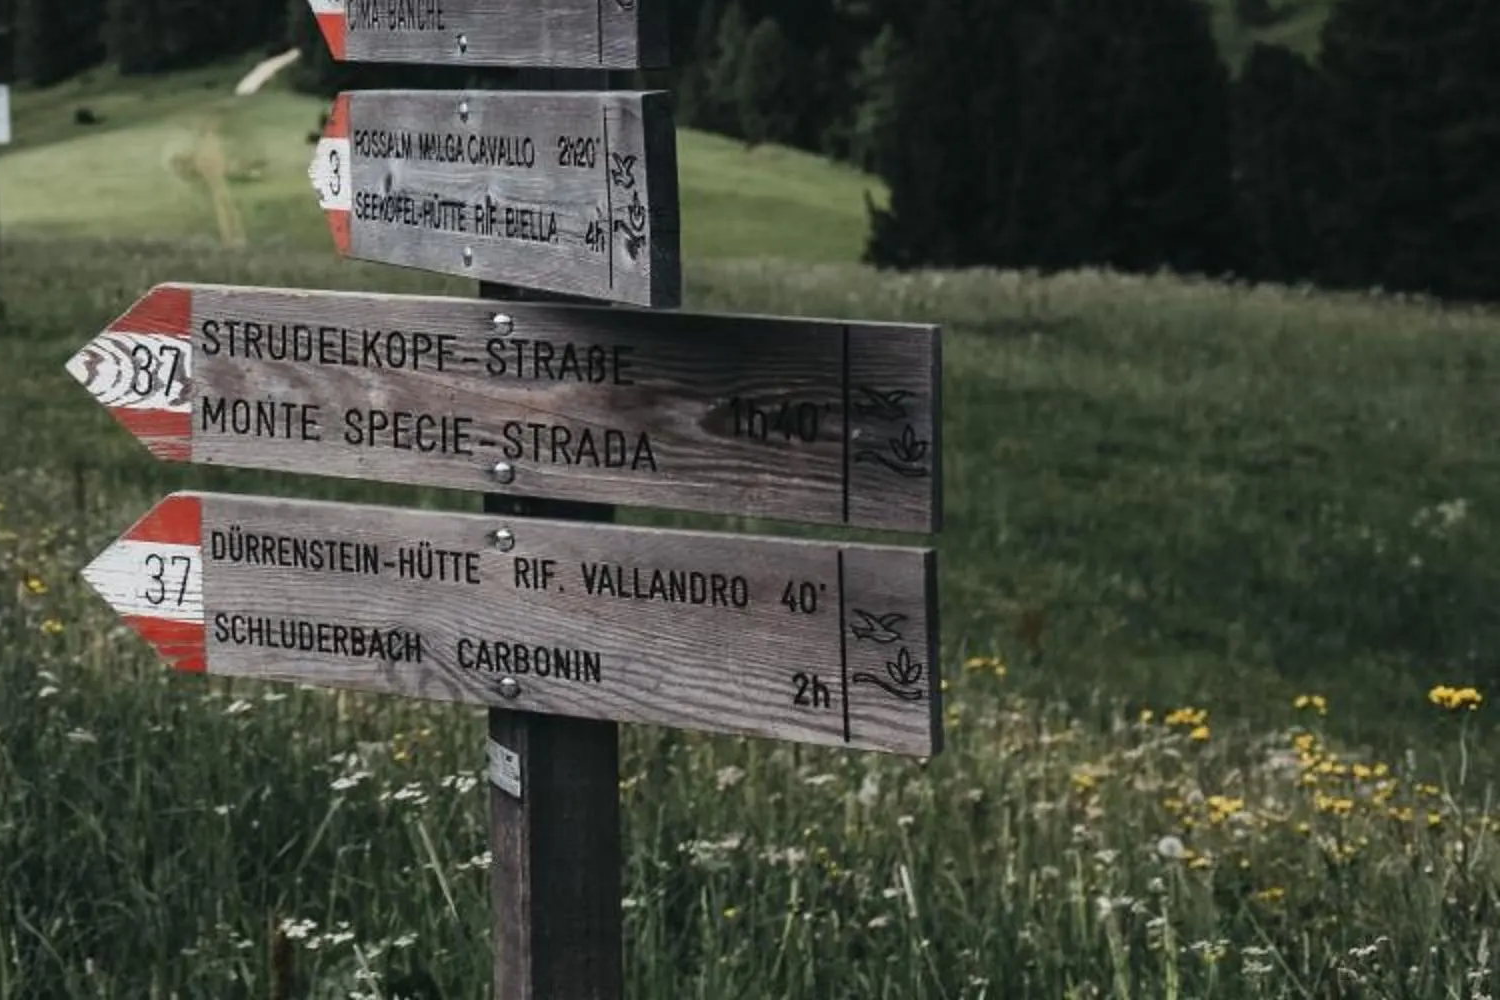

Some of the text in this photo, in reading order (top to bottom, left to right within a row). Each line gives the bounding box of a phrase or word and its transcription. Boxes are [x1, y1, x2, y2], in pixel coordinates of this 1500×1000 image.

[329, 149, 341, 196] 3
[419, 132, 465, 163] MALGA
[467, 134, 535, 168] CAVALLO
[131, 343, 181, 397] 37
[201, 395, 323, 442] MONTE
[344, 408, 657, 473] SPECIE-STRADA
[144, 554, 192, 608] 37
[211, 526, 481, 584] DÜRRENSTEIN-HÜTTE
[513, 557, 566, 593] RIF.
[581, 561, 749, 609] VALLANDRO
[214, 613, 831, 709] SCHLUDERBACH CARBONIN 2h
